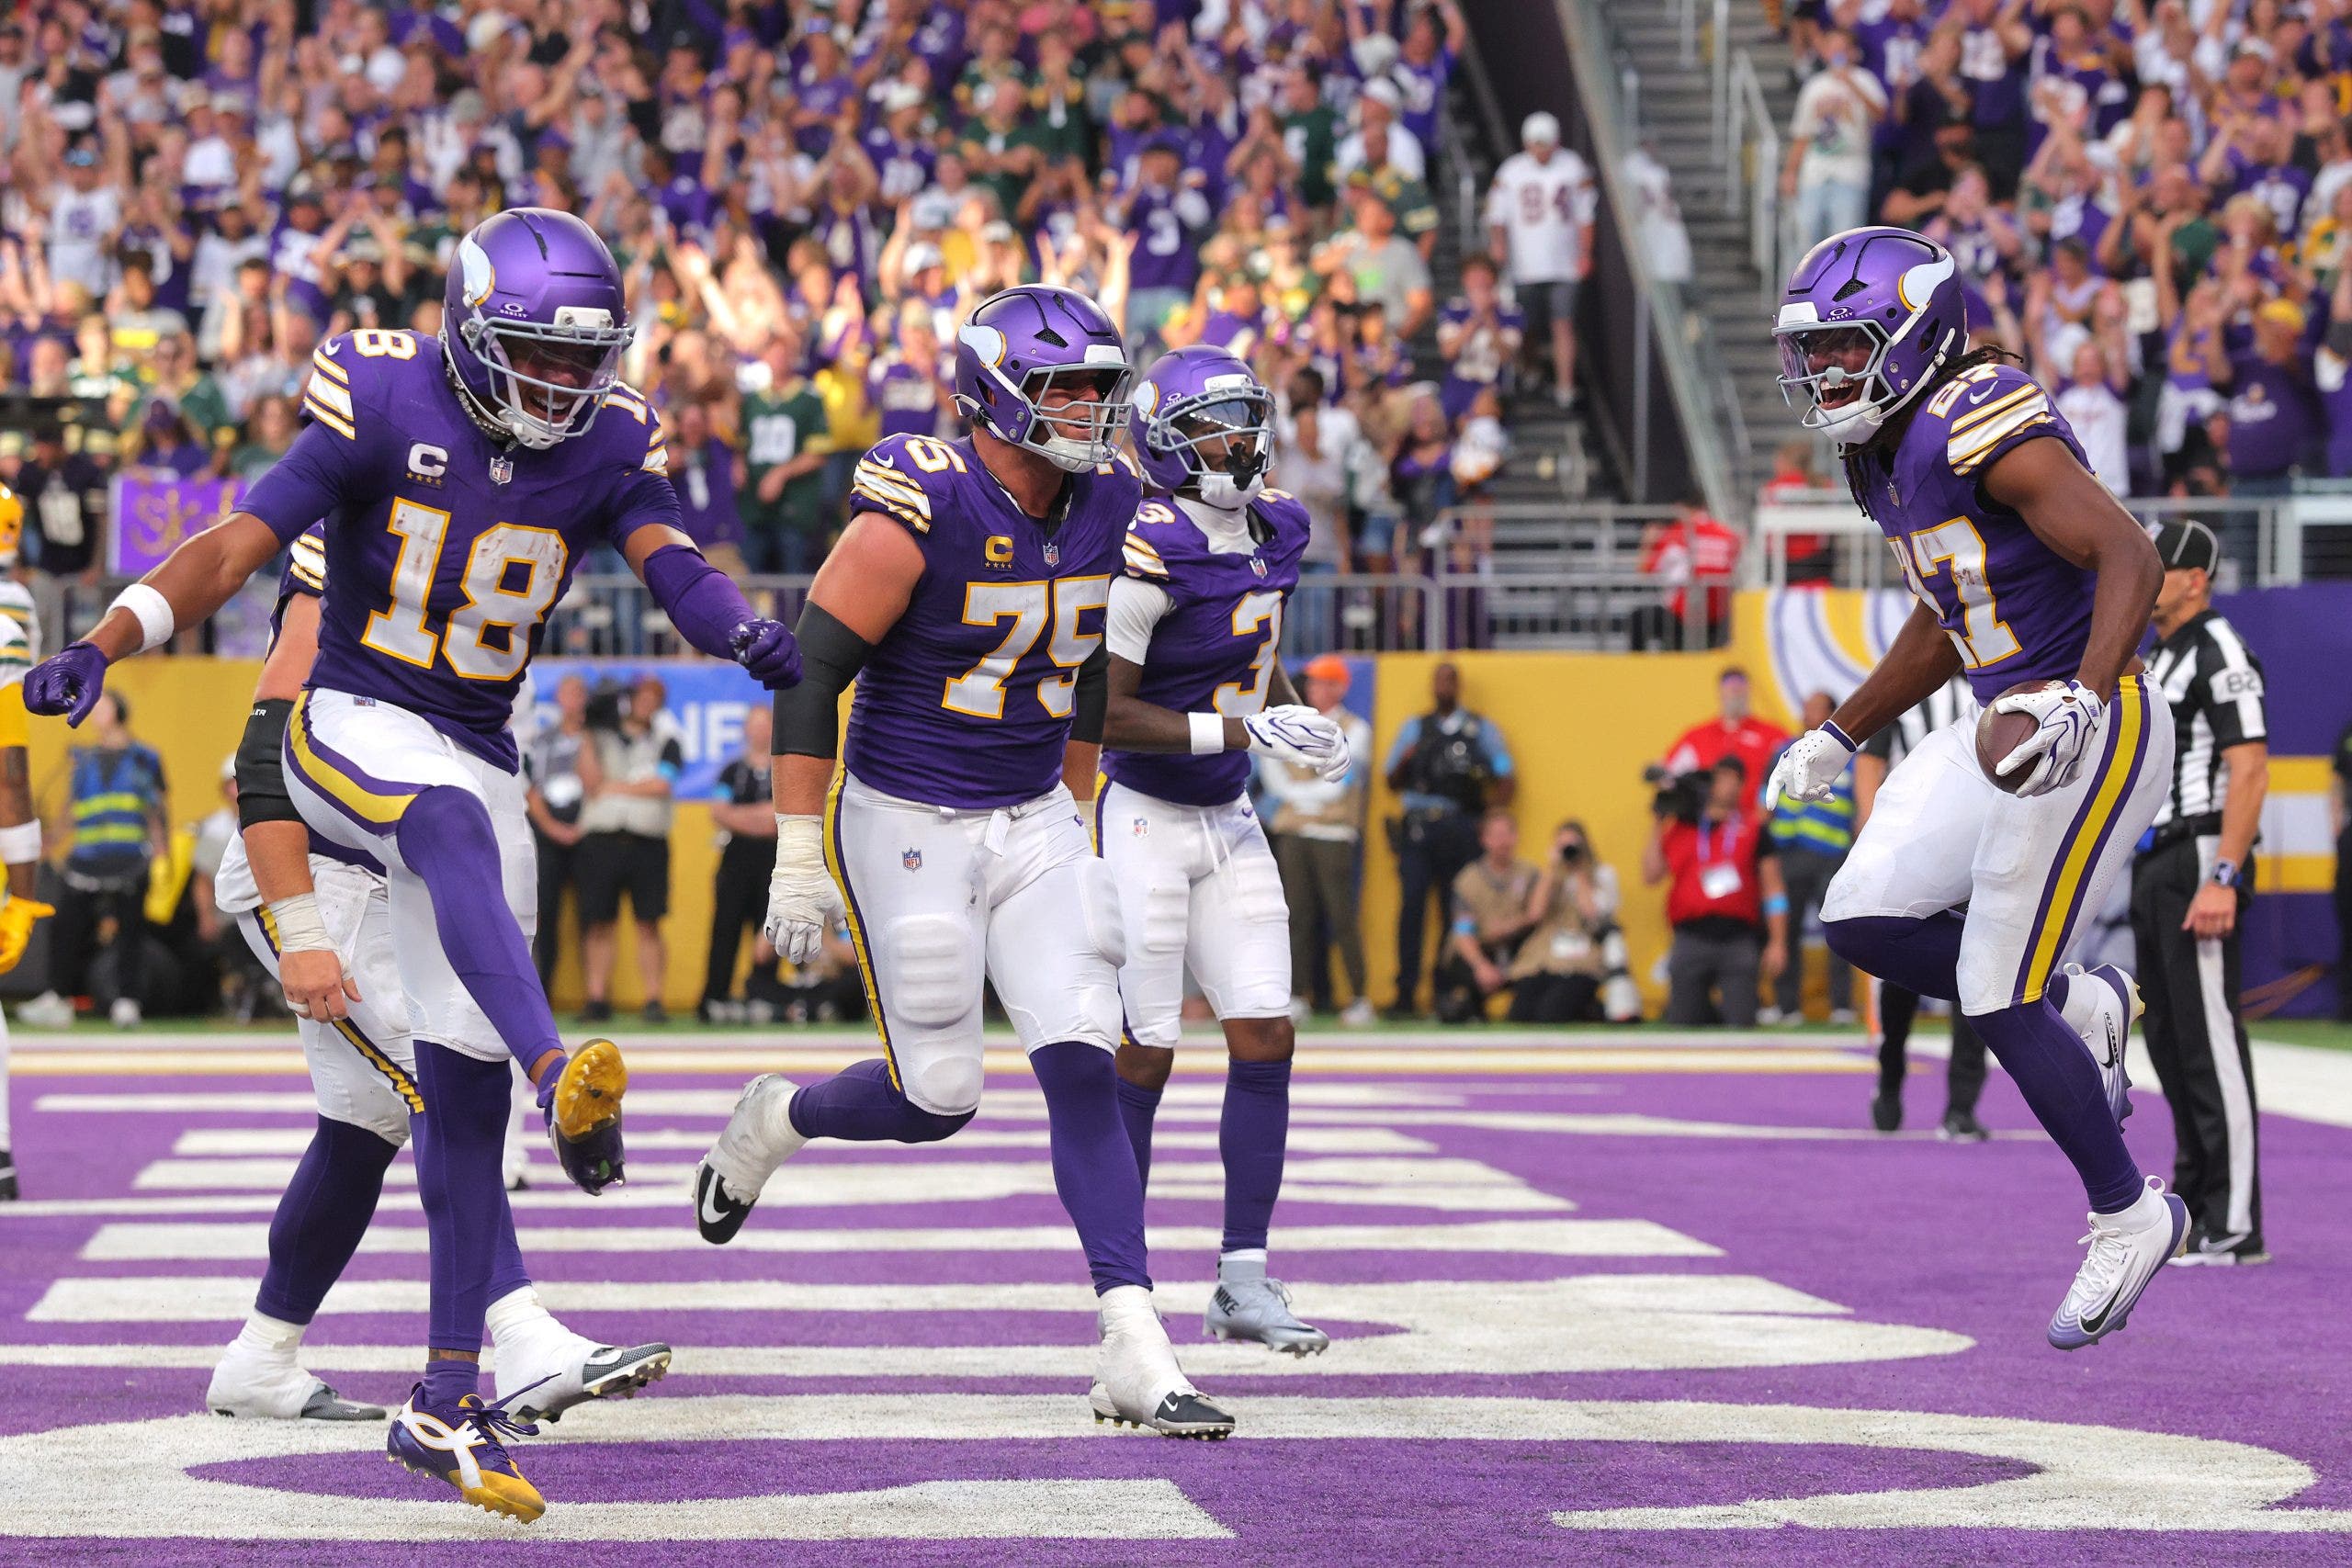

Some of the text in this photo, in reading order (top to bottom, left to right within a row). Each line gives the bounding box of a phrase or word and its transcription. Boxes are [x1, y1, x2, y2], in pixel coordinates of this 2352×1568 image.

[408, 443, 448, 478] C
[360, 496, 570, 682] 18
[985, 536, 1013, 563] C
[942, 573, 1112, 719] 75
[1213, 589, 1284, 718] 3
[1214, 1284, 1239, 1317] NIKE
